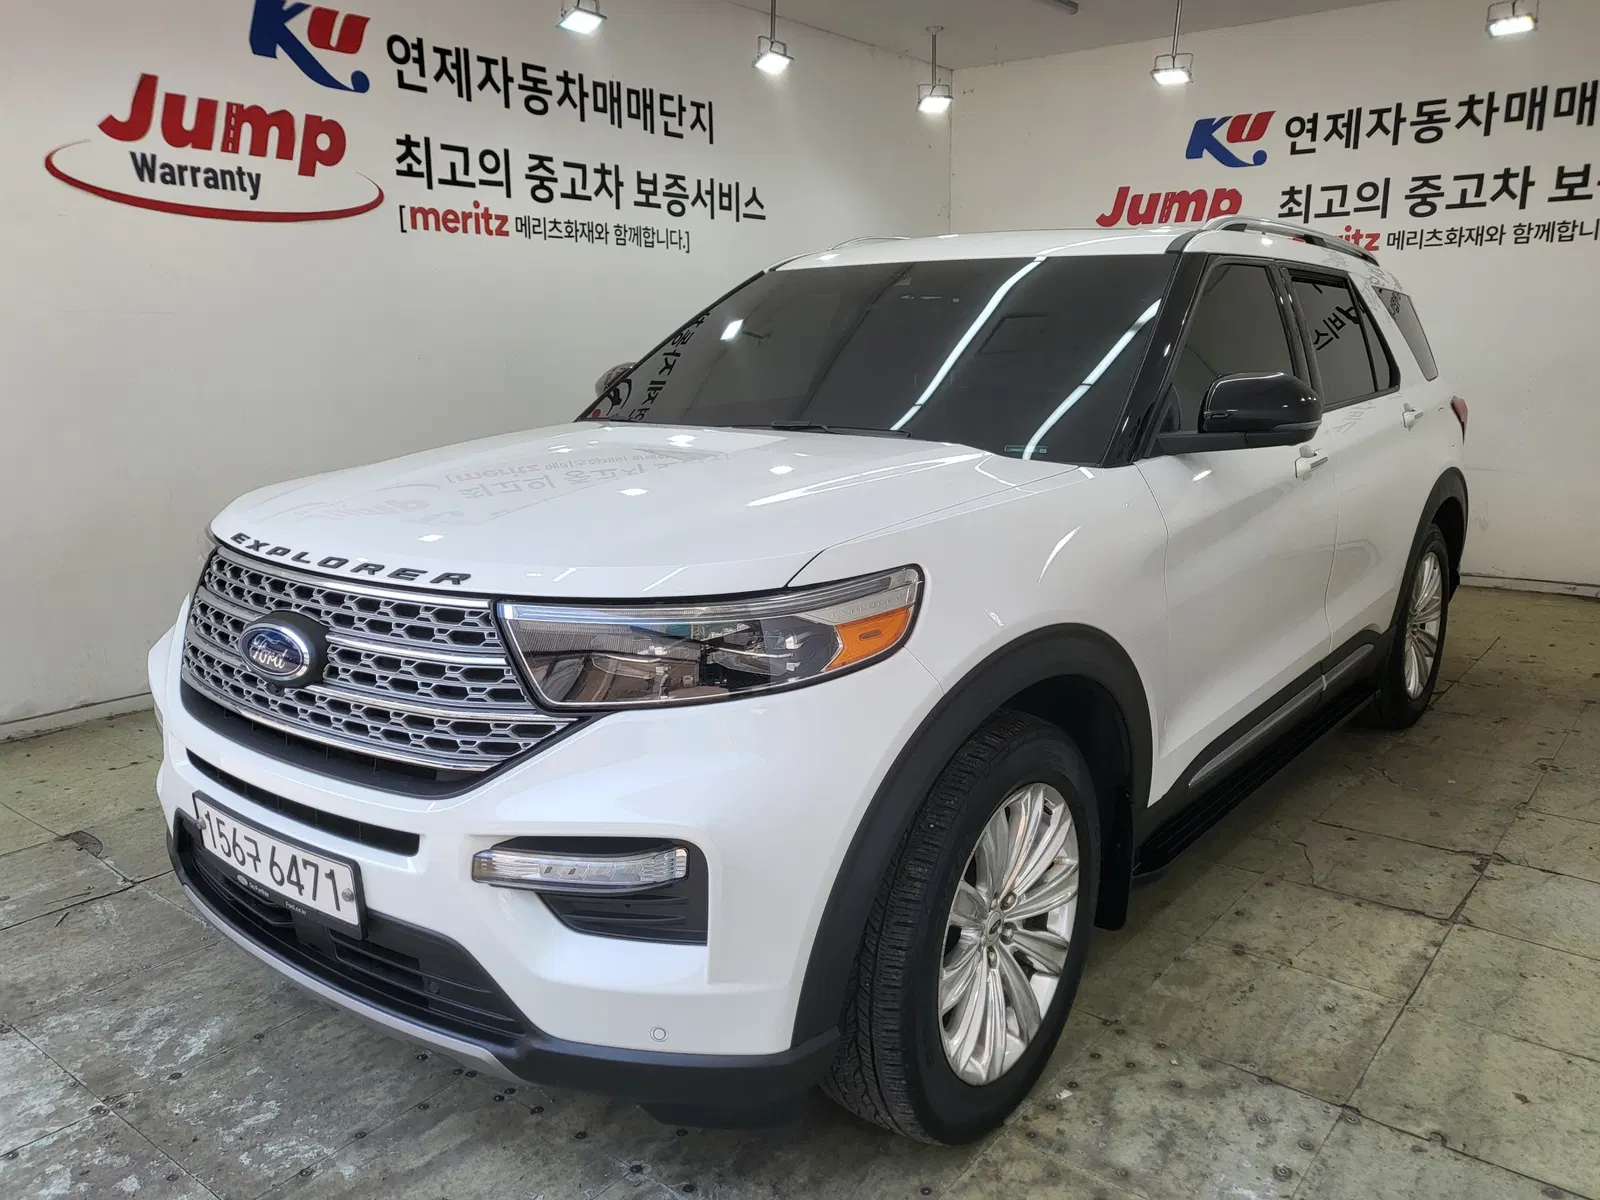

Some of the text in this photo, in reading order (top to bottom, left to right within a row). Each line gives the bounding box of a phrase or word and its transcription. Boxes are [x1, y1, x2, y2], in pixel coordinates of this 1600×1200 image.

[386, 33, 715, 145] 연제자동차매매단지
[97, 72, 346, 177] Jump
[1284, 80, 1600, 156] 연제자동차매매
[129, 150, 261, 200] Warranty
[395, 133, 766, 222] 최고의 중고차 보증서비스
[1278, 163, 1600, 224] 최고의 중고차 보
[515, 214, 610, 245] 메리츠화재와
[1095, 186, 1243, 227] Jump
[1386, 224, 1505, 251] 메리츠화재와
[230, 531, 472, 585] EXPLORER
[250, 633, 286, 670] Ford
[269, 845, 341, 911] 6471
